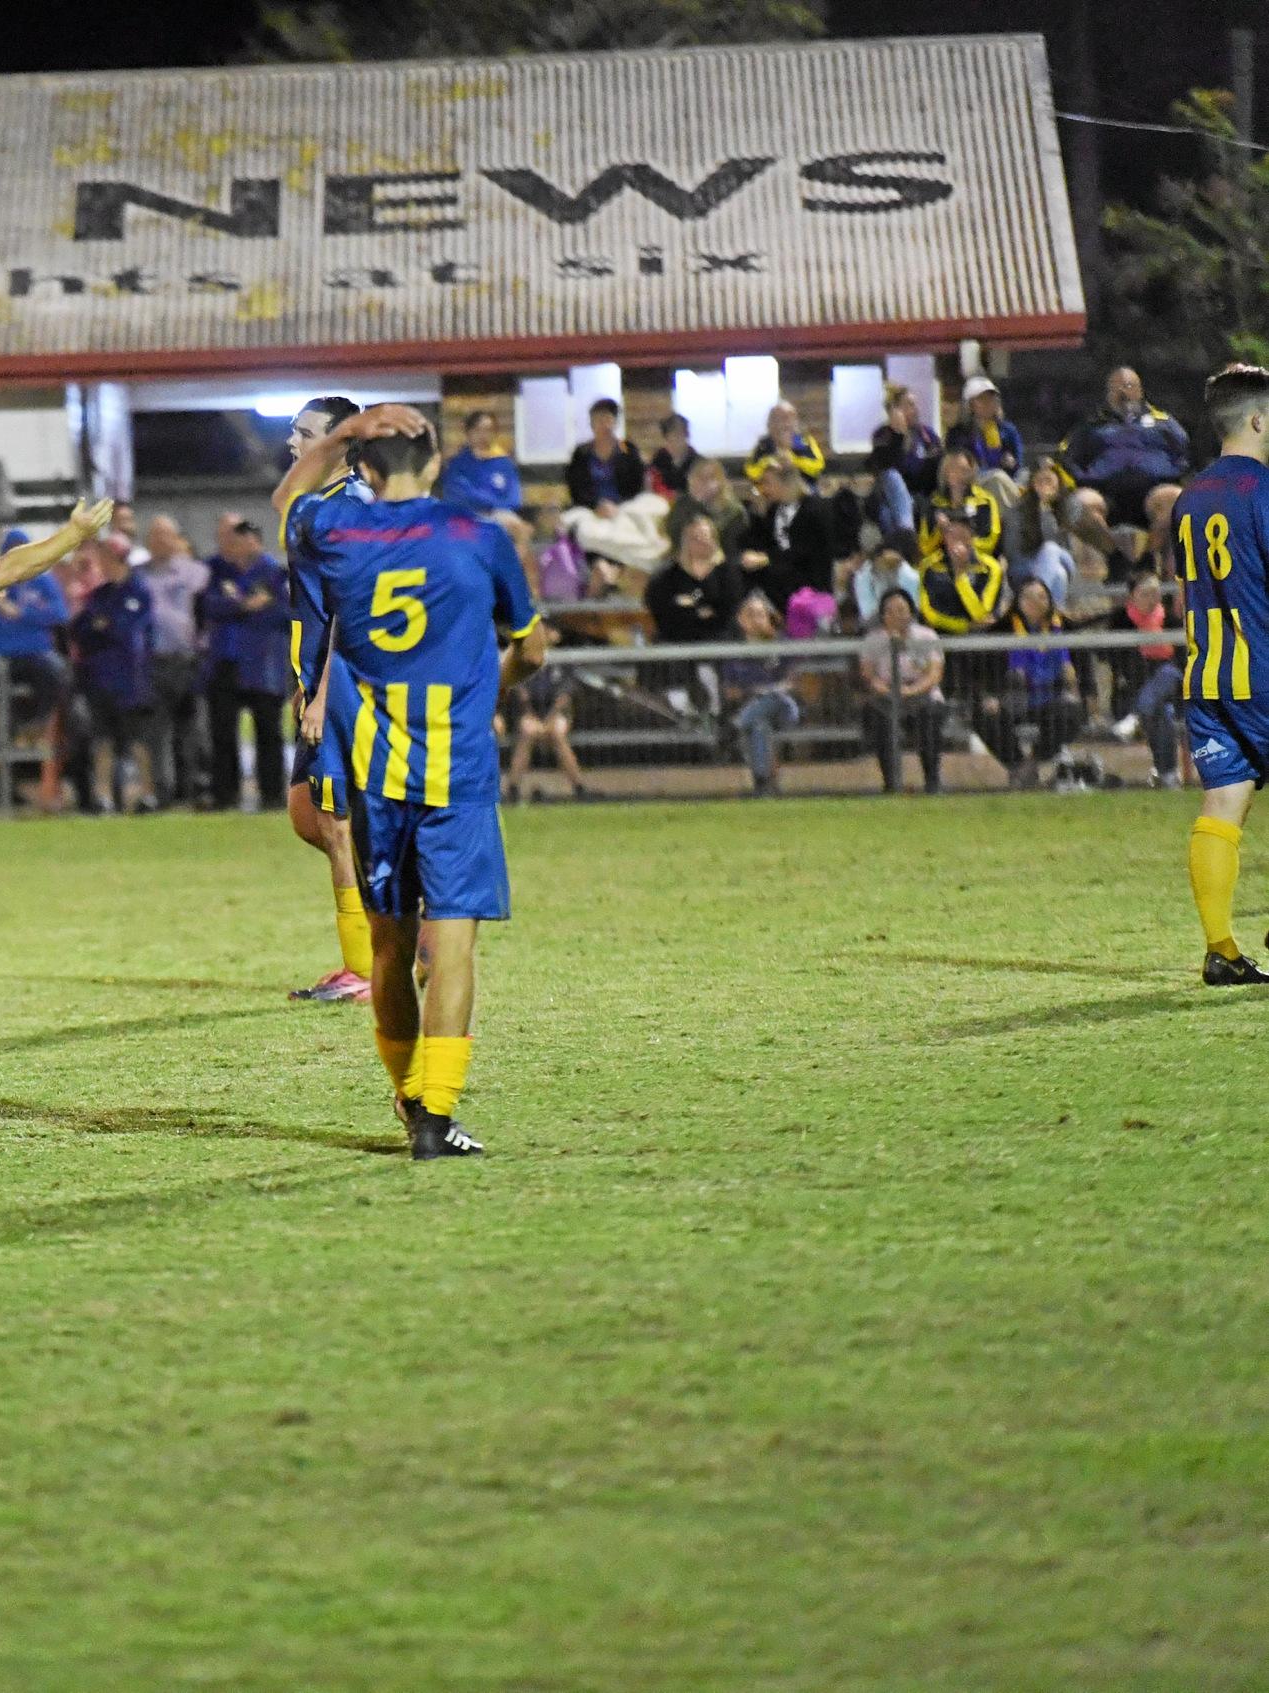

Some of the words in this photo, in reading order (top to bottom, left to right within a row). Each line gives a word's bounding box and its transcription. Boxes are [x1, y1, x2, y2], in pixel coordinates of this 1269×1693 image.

[73, 150, 955, 241] NEWS
[324, 259, 481, 288] at
[553, 246, 765, 281] six
[1178, 513, 1233, 582] 18
[368, 567, 427, 653] 5
